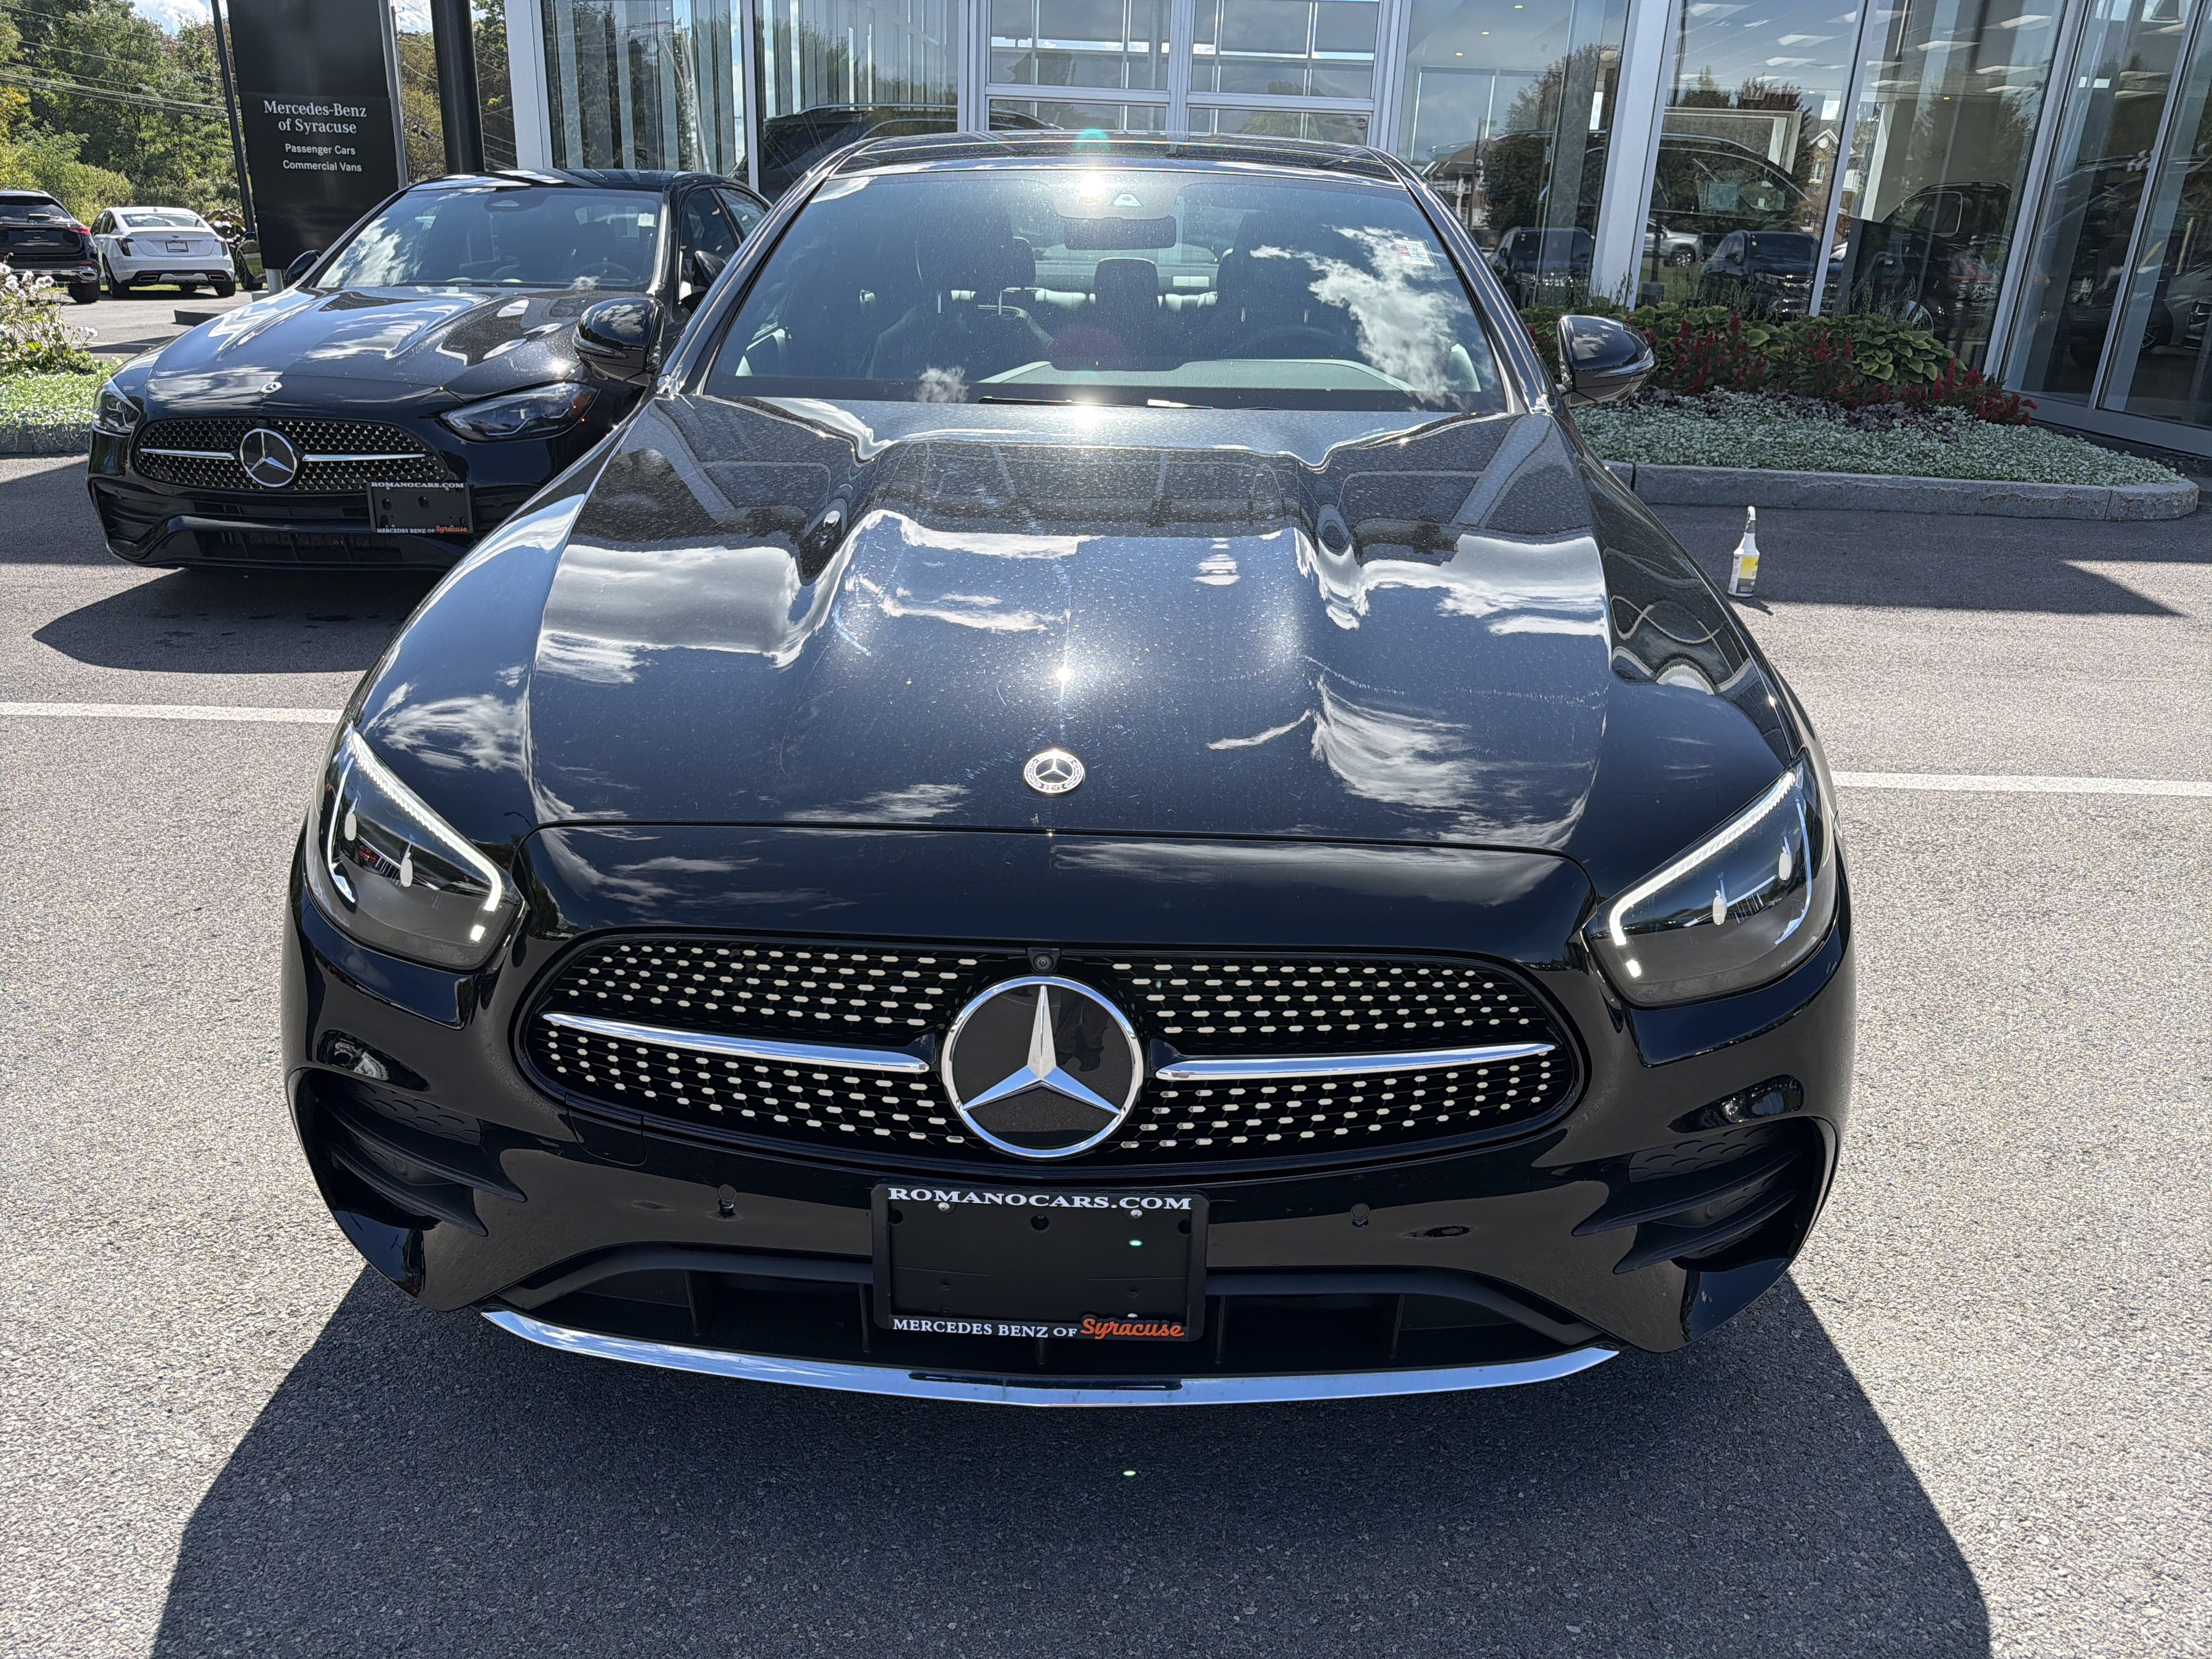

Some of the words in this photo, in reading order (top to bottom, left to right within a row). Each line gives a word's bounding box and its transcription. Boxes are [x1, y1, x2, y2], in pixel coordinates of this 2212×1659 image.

[263, 100, 367, 117] Mercedes-Benz
[278, 118, 292, 131] of
[295, 119, 357, 135] Syracuse
[285, 143, 332, 156] Passenger
[335, 145, 356, 155] Cars
[283, 160, 337, 171] Commercial
[340, 162, 362, 172] Vans
[435, 525, 468, 533] Syracuse
[888, 1187, 1192, 1210] ROMANOCARS.COM
[893, 1319, 992, 1335] MERCEDES
[997, 1324, 1048, 1338] BENZ
[1053, 1327, 1077, 1338] OF
[1080, 1318, 1184, 1340] Syracuse
